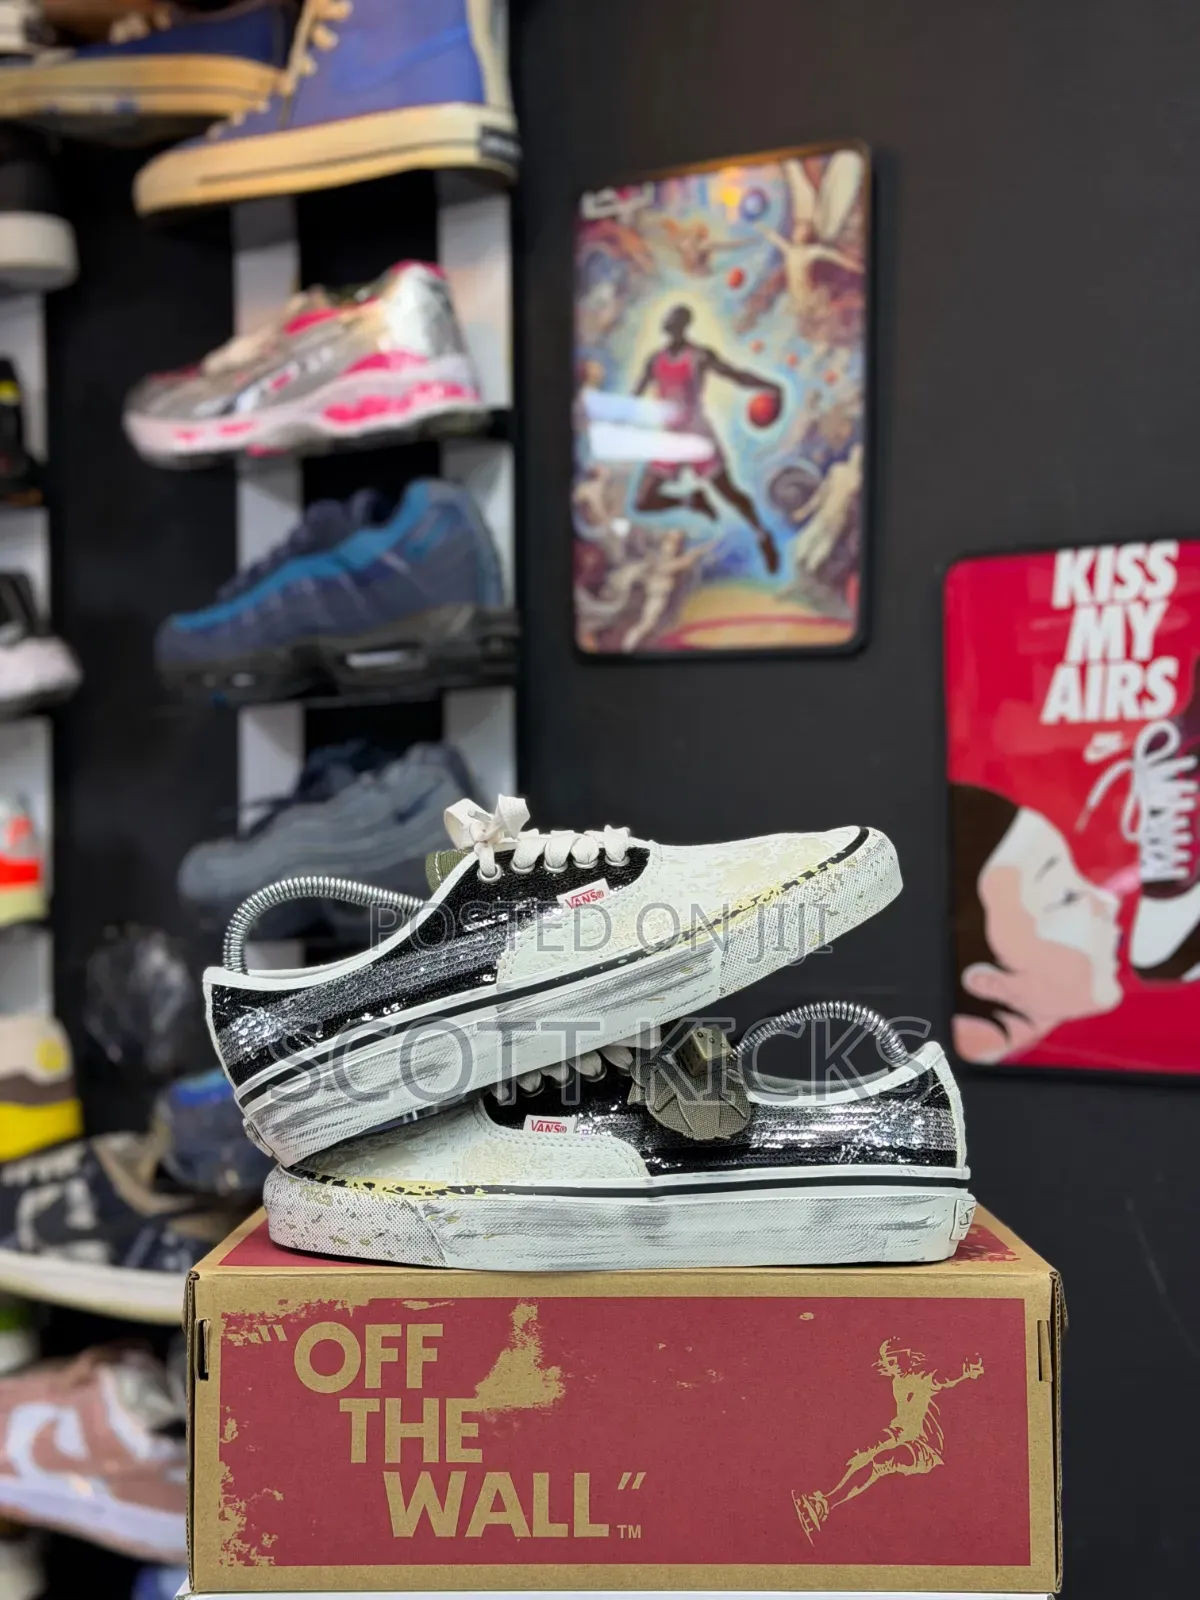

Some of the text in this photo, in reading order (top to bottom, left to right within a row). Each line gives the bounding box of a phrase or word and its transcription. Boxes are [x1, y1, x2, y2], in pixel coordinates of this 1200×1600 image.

[1052, 539, 1179, 610] KISS
[1064, 600, 1169, 666] MY
[1040, 657, 1179, 725] AIRS
[339, 1398, 483, 1463] THE
